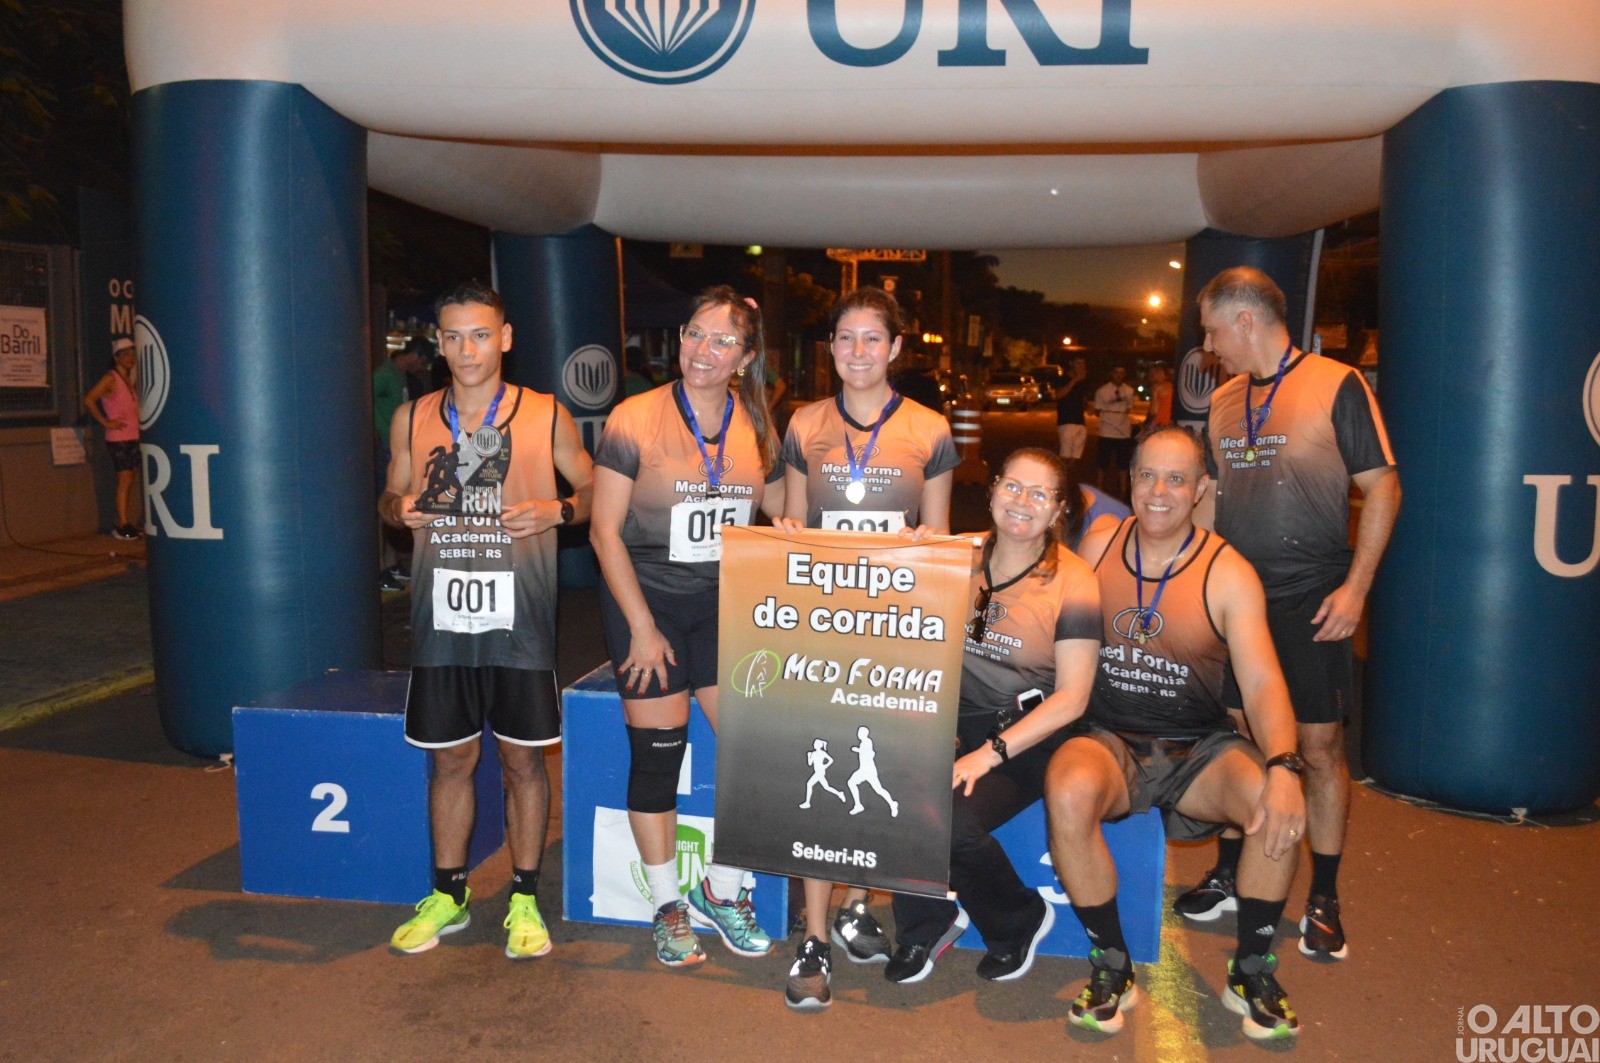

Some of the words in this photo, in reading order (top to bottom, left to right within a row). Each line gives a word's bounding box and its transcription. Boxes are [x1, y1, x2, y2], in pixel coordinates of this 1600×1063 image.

[13, 325, 29, 339] Do
[0, 334, 41, 355] Barril
[1220, 436, 1246, 450] Med
[1254, 434, 1287, 446] orma
[821, 463, 851, 474] Med
[856, 465, 902, 477] orma
[829, 474, 892, 485] Acaemia
[461, 482, 502, 514] RUN
[674, 480, 707, 493] Med
[716, 482, 754, 495] orma
[429, 531, 512, 544] Academia
[439, 549, 476, 558] SEBERI
[485, 549, 502, 558] RS
[787, 552, 916, 598] Equipe
[447, 577, 496, 613] 001
[753, 597, 800, 631] de
[808, 605, 945, 642] corrida
[781, 653, 841, 683] MED
[847, 658, 943, 693] FORMA
[1102, 662, 1186, 686] Academia
[830, 687, 939, 714] Academia
[310, 782, 350, 833] 2
[791, 842, 877, 868] Seberi-RS
